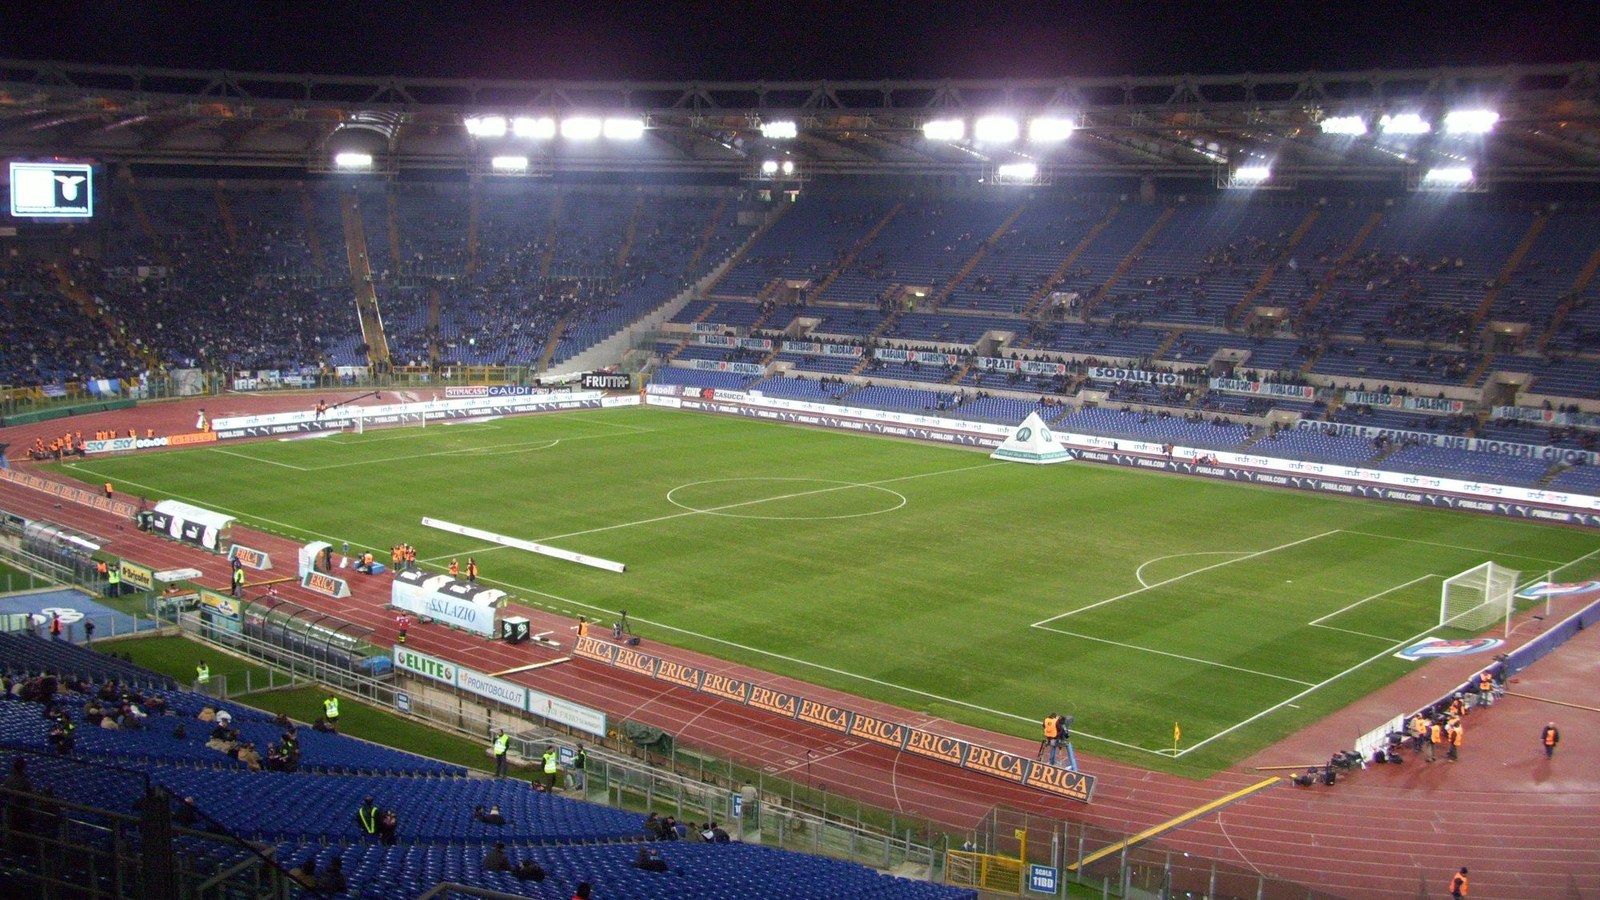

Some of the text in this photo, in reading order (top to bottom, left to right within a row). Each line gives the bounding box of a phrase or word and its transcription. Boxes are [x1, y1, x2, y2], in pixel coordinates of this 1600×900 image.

[985, 358, 1014, 370] PRATI
[1095, 367, 1177, 385] SODALIZIO
[714, 392, 744, 401] CASUCCI
[1414, 397, 1452, 411] TALENTI
[87, 439, 133, 451] SKY SKY
[1475, 439, 1536, 458] NOSTRI
[930, 432, 954, 441] PUMA.COM
[1082, 452, 1109, 461] PUMA.COM
[1138, 458, 1166, 468] PUMA.COM
[1195, 466, 1225, 476] PUMA.COM
[1256, 474, 1287, 484] PUMA.COM
[1321, 482, 1353, 493] PUMA.COM
[1387, 490, 1421, 502] PUMA.COM
[1458, 499, 1494, 511] PUMA.COM
[1532, 508, 1569, 521] PUMA.COM
[236, 548, 258, 564] ERICA
[310, 572, 335, 592] ERICA
[406, 652, 444, 679] ELITE
[467, 676, 522, 703] PRONTOBOLLO.IT
[576, 637, 613, 659] ERICA
[616, 647, 654, 672] ERICA
[658, 660, 699, 684] ERICA
[703, 672, 746, 697] ERICA
[751, 686, 795, 713] ERICA
[800, 699, 847, 727] ERICA
[853, 714, 903, 743] ERICA
[909, 729, 961, 759] ERICA
[968, 745, 1022, 776] ERICA
[1029, 762, 1088, 794] ERICA
[1034, 867, 1053, 878] SCALA
